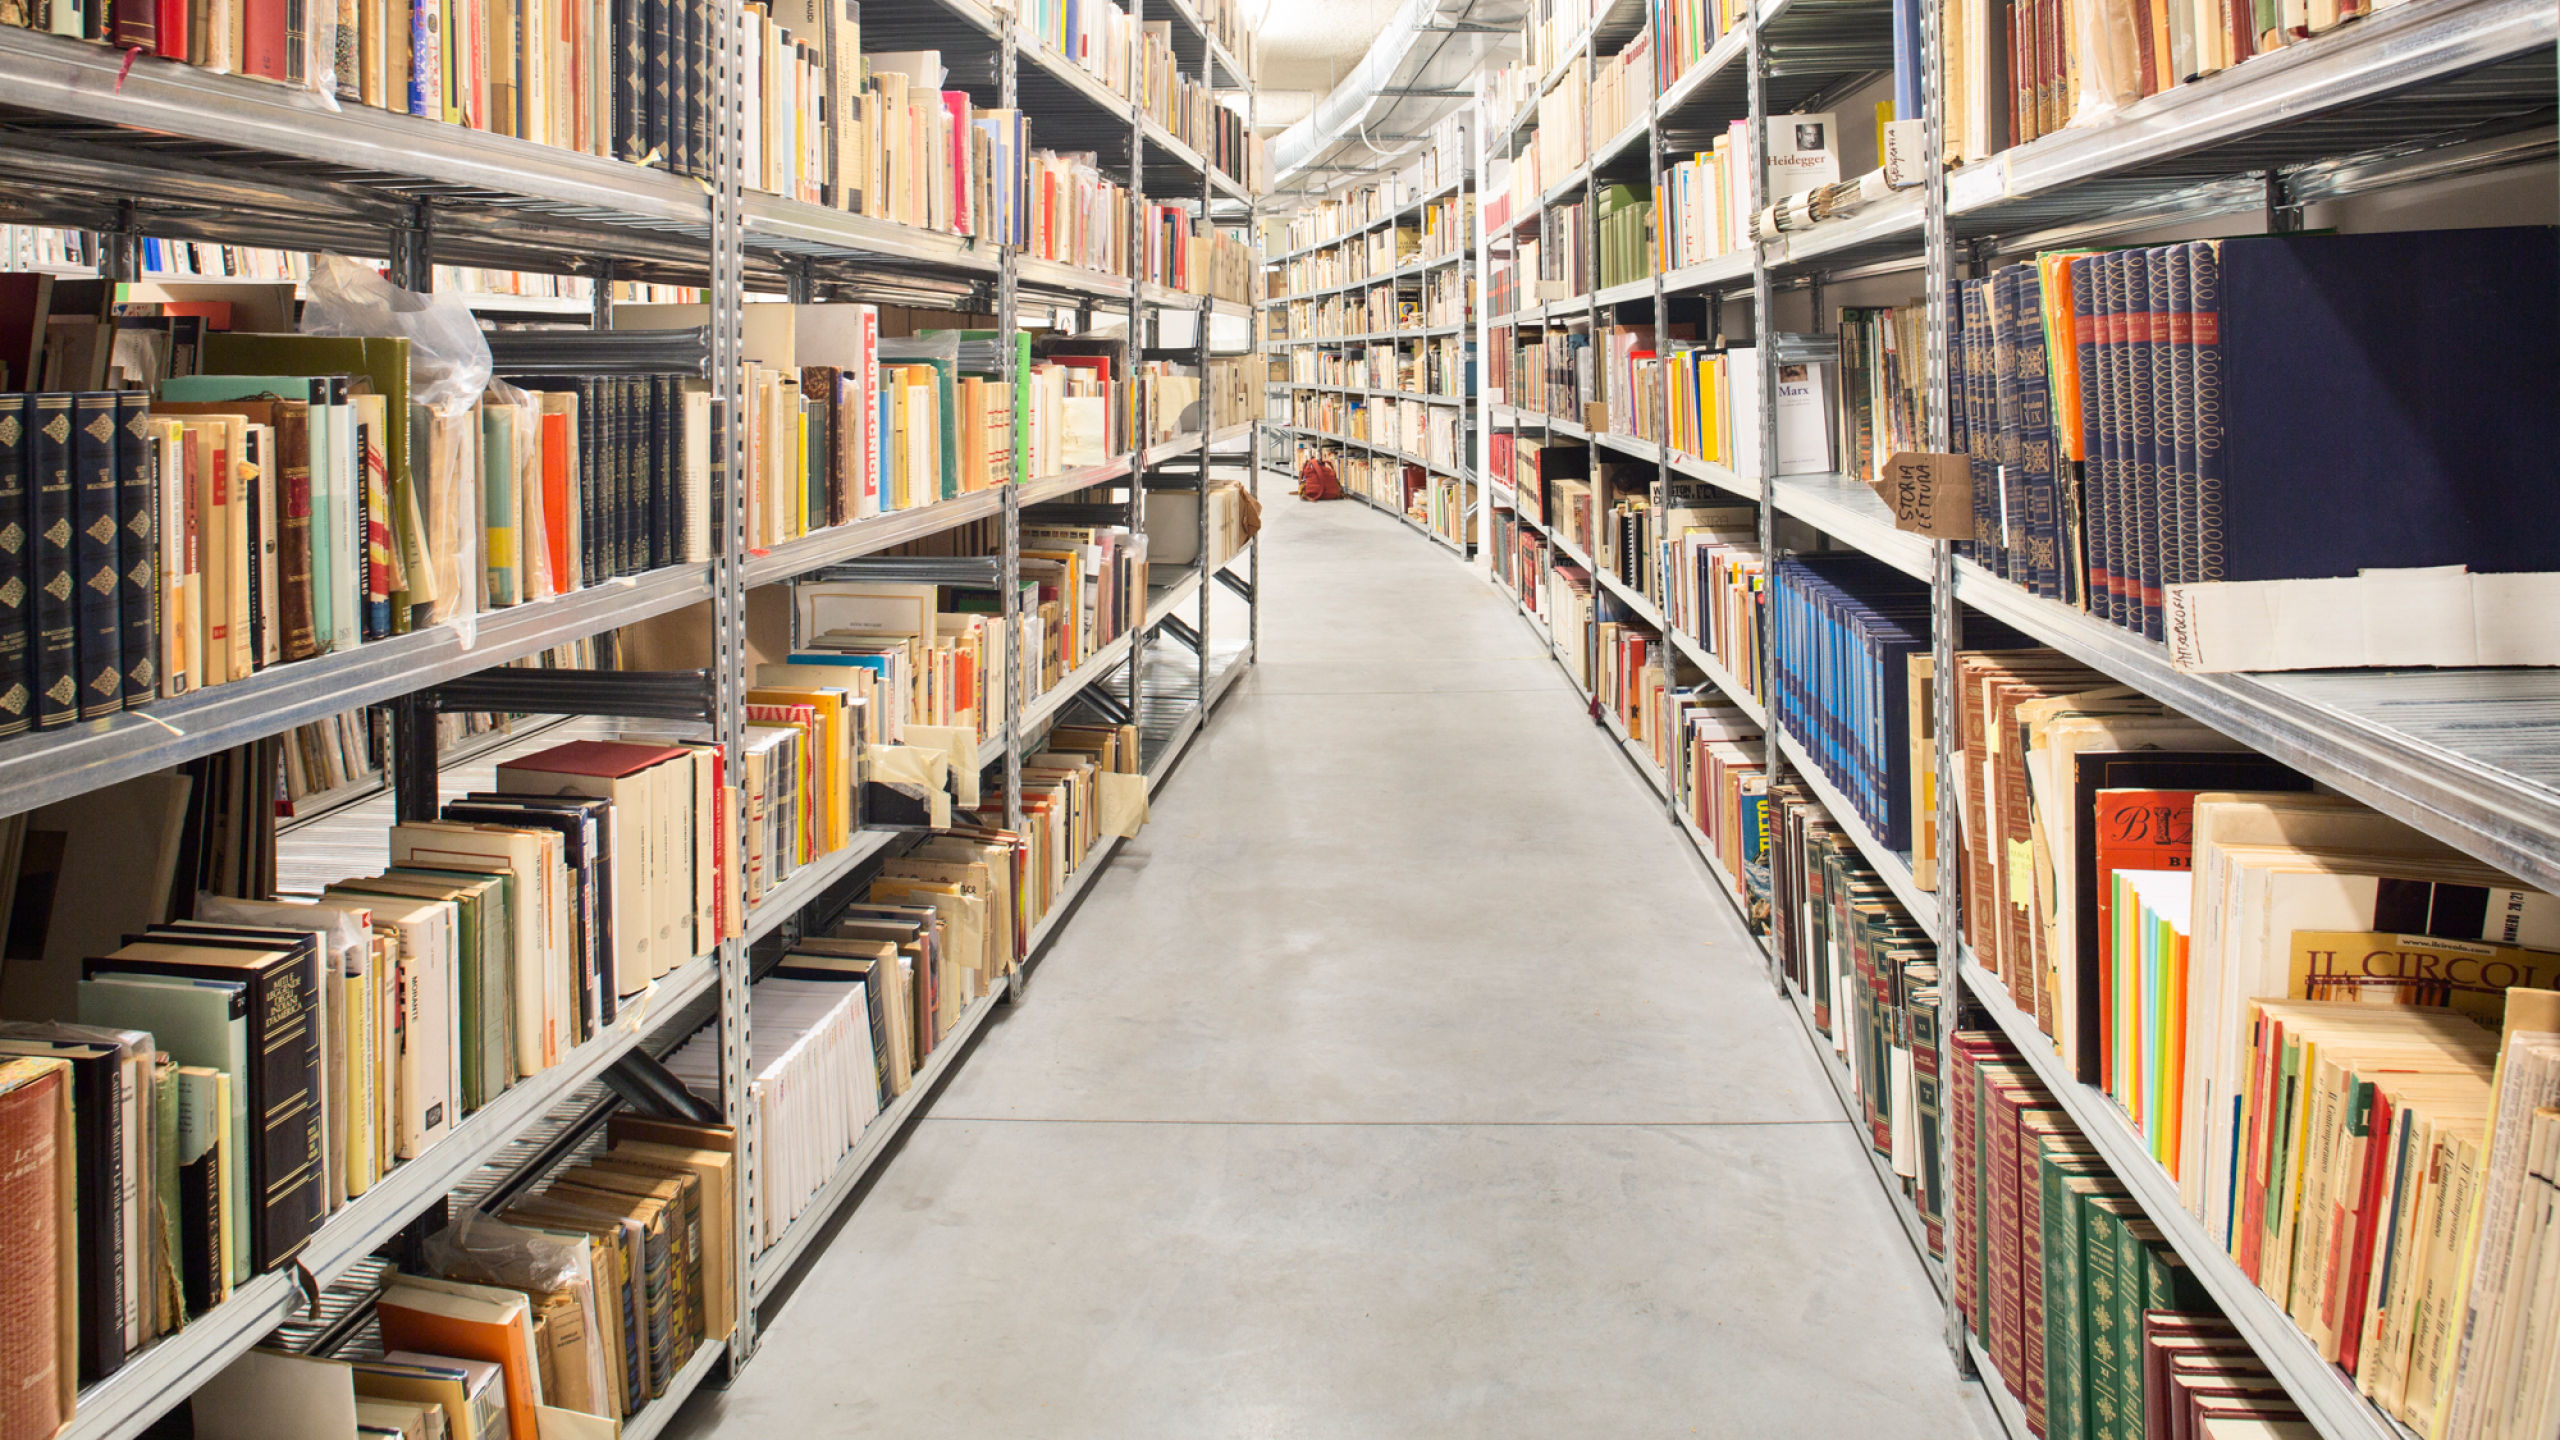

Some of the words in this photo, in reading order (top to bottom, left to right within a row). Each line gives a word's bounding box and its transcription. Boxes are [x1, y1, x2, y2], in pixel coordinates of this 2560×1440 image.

[1767, 154, 1825, 168] Heidegger
[868, 321, 876, 341] IL
[1779, 386, 1809, 397] Marx
[868, 347, 877, 487] POLITECNICO
[1899, 465, 1915, 521] STORIA
[359, 507, 367, 543] LETTERA
[2507, 891, 2523, 912] 20/21
[2503, 914, 2519, 942] NUMERO
[2402, 937, 2491, 955] www.ilcircolo.com
[2306, 950, 2348, 977] IL
[2361, 949, 2560, 989] CIRCOL
[266, 975, 301, 1001] LEGGENDE
[273, 977, 288, 990] MITI
[270, 996, 298, 1016] INDIANI
[274, 992, 294, 1007] DEGLI
[266, 1002, 303, 1028] D'AMERICA
[112, 1071, 121, 1122] CATHERINE
[113, 1124, 122, 1162] MILLET
[2322, 1103, 2337, 1173] Contemporaneo
[113, 1171, 122, 1190] La
[208, 1159, 217, 1201] PIETÀ
[2403, 1140, 2418, 1218] Contemporaneo
[114, 1192, 122, 1209] vita
[2435, 1164, 2452, 1238] Contemporaneo
[2449, 1177, 2466, 1252] Contemporaneo
[113, 1210, 123, 1250] sessuale
[114, 1253, 123, 1263] di
[210, 1235, 220, 1282] MORTA
[114, 1266, 124, 1315] Catherine
[115, 1317, 124, 1335] M.
